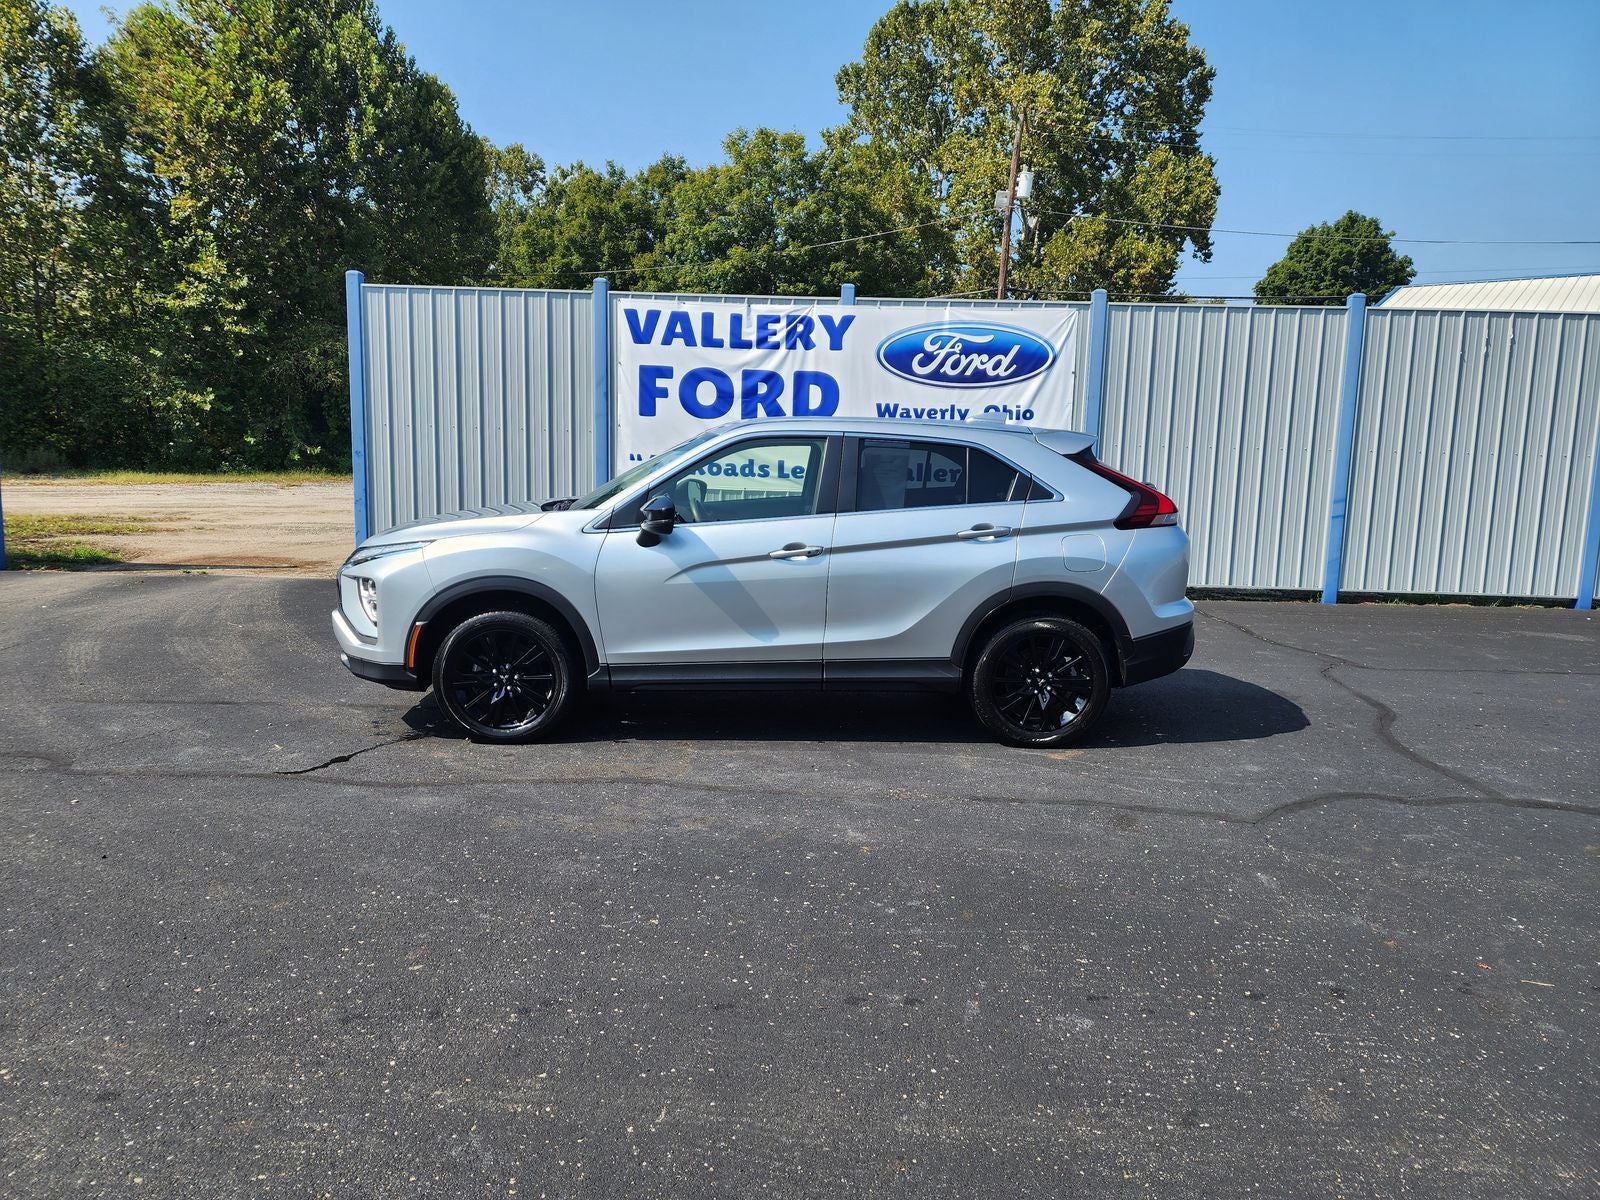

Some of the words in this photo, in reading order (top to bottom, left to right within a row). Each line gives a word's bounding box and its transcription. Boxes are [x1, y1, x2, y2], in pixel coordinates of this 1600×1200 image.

[624, 308, 856, 351] VALLERY
[911, 331, 1021, 377] Ford
[639, 364, 840, 420] FORD
[876, 402, 969, 421] Waverly
[777, 460, 806, 479] Le
[906, 462, 962, 483] aller
